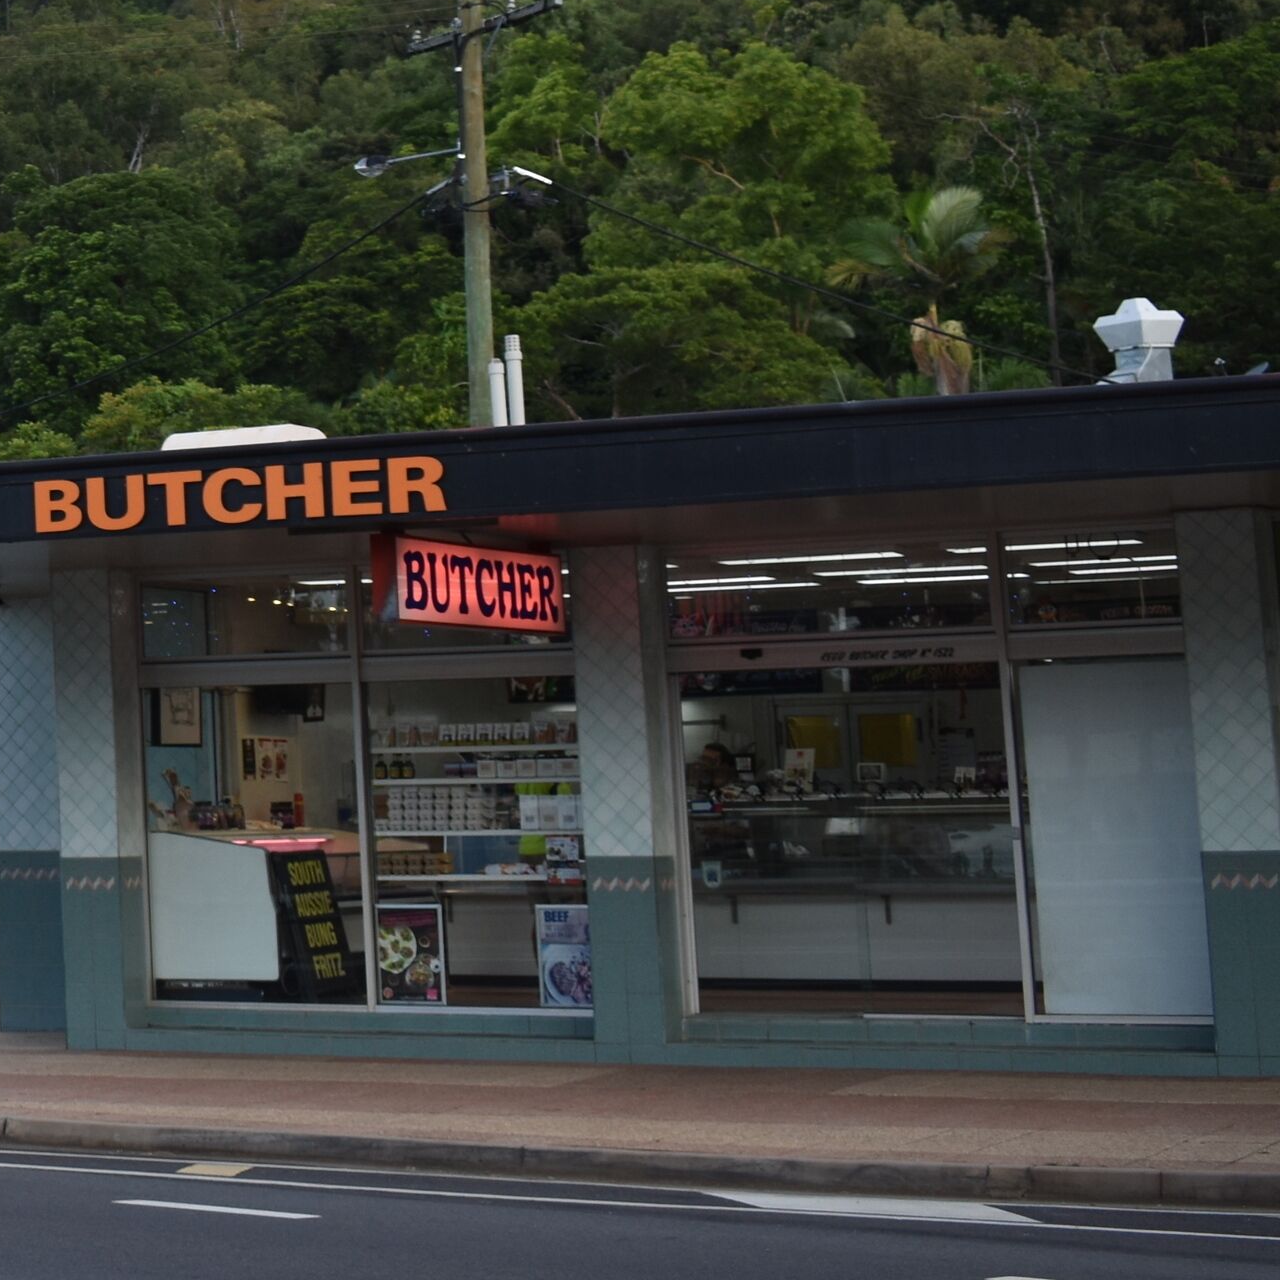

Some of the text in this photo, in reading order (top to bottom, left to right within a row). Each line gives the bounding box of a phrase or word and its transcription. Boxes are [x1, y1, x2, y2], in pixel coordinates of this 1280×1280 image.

[33, 457, 446, 533] BUTCHER
[403, 550, 558, 623] BUTCHER
[287, 860, 326, 886] SOUTH
[294, 889, 335, 917] AUSSIE
[544, 910, 569, 923] BEEF
[305, 921, 338, 948] BUNG
[312, 952, 347, 979] FRITZ
